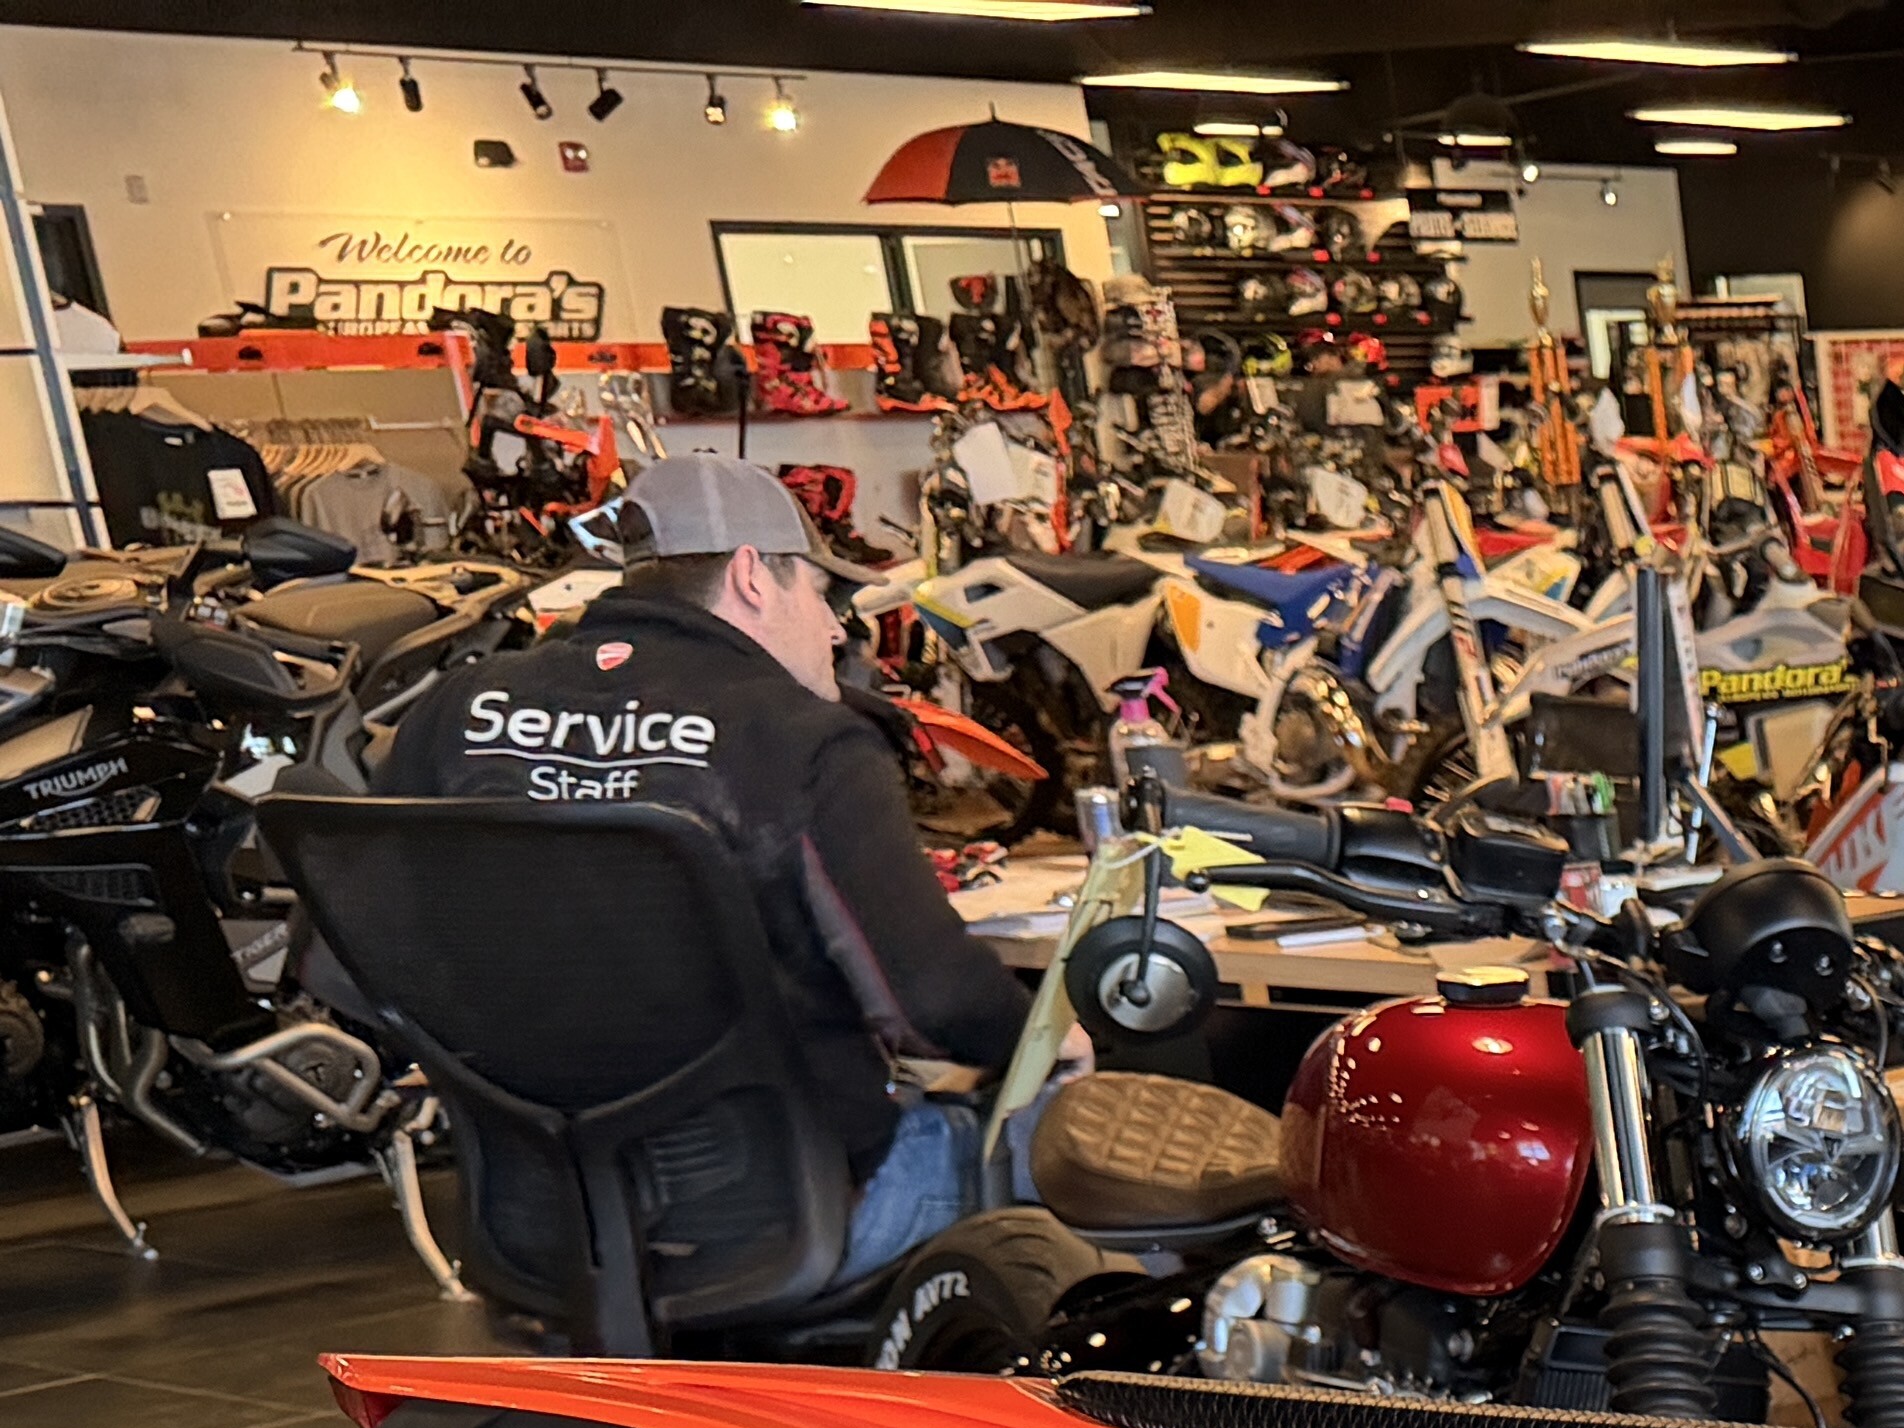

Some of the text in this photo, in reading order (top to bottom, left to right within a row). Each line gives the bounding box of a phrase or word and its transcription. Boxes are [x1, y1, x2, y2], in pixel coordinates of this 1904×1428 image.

[318, 231, 533, 266] Welcome to
[268, 268, 602, 322] Pandora's
[1702, 657, 1857, 694] Pandora'
[464, 690, 716, 756] Service
[22, 757, 130, 800] TRIUMPH
[527, 765, 642, 801] Staff
